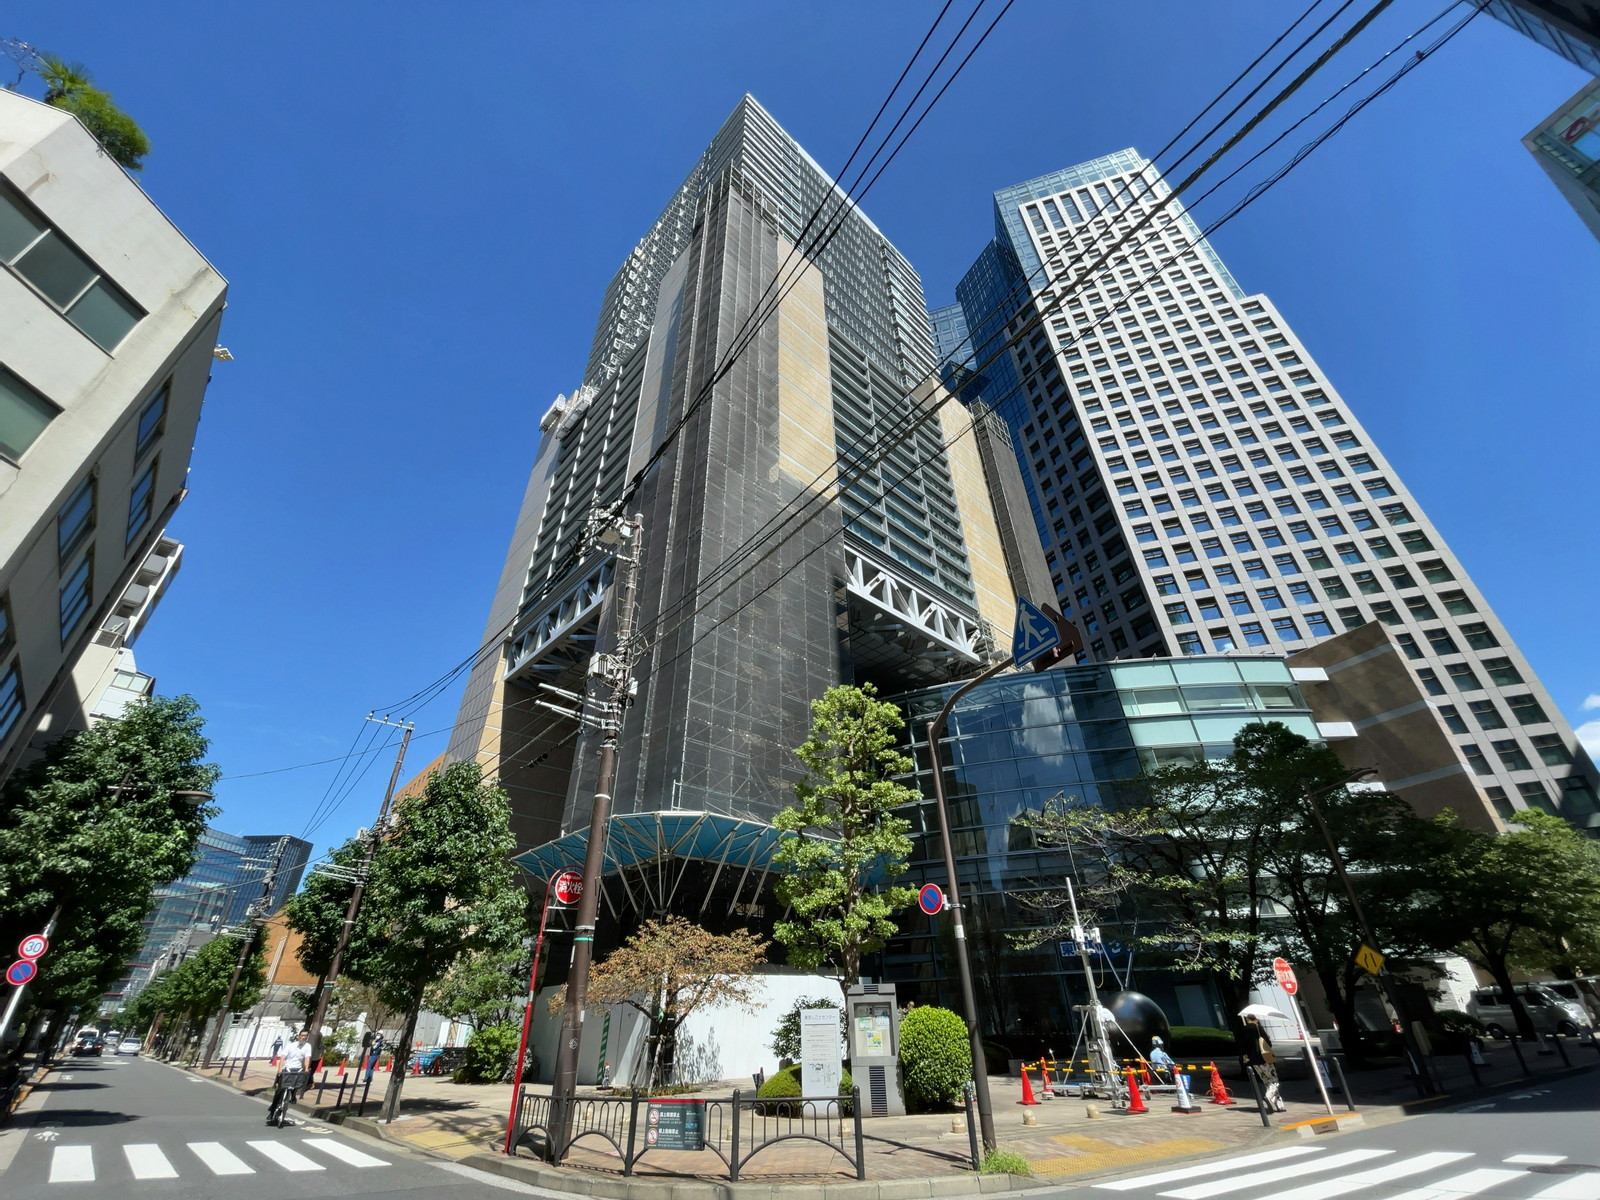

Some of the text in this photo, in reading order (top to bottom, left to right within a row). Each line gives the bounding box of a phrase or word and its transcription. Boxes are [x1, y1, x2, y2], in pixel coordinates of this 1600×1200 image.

[559, 880, 583, 894] 消火栓
[25, 941, 42, 953] 30
